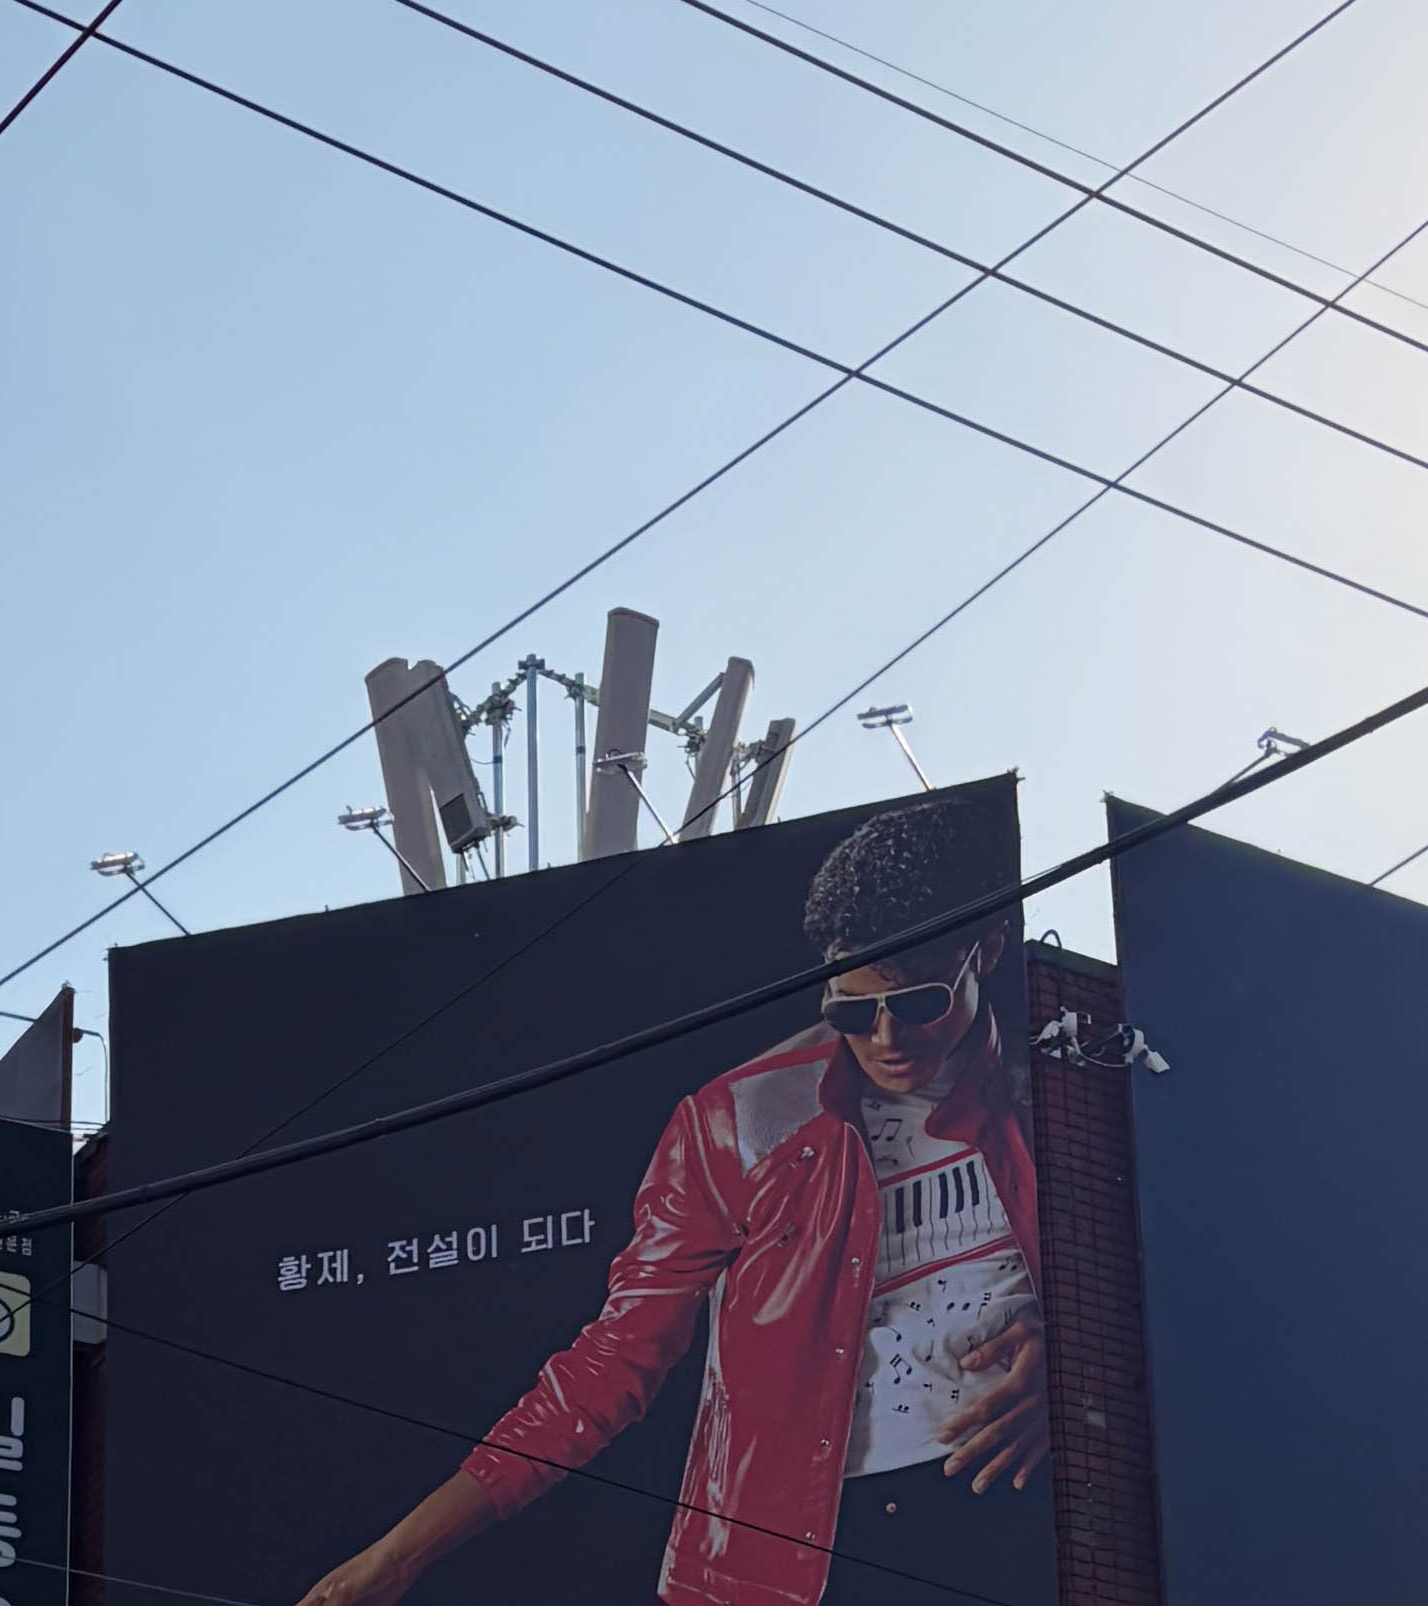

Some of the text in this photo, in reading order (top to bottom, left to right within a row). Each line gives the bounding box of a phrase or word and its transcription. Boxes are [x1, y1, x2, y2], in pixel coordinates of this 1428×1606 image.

[277, 1208, 596, 1293] 황제, 전설이 되다
